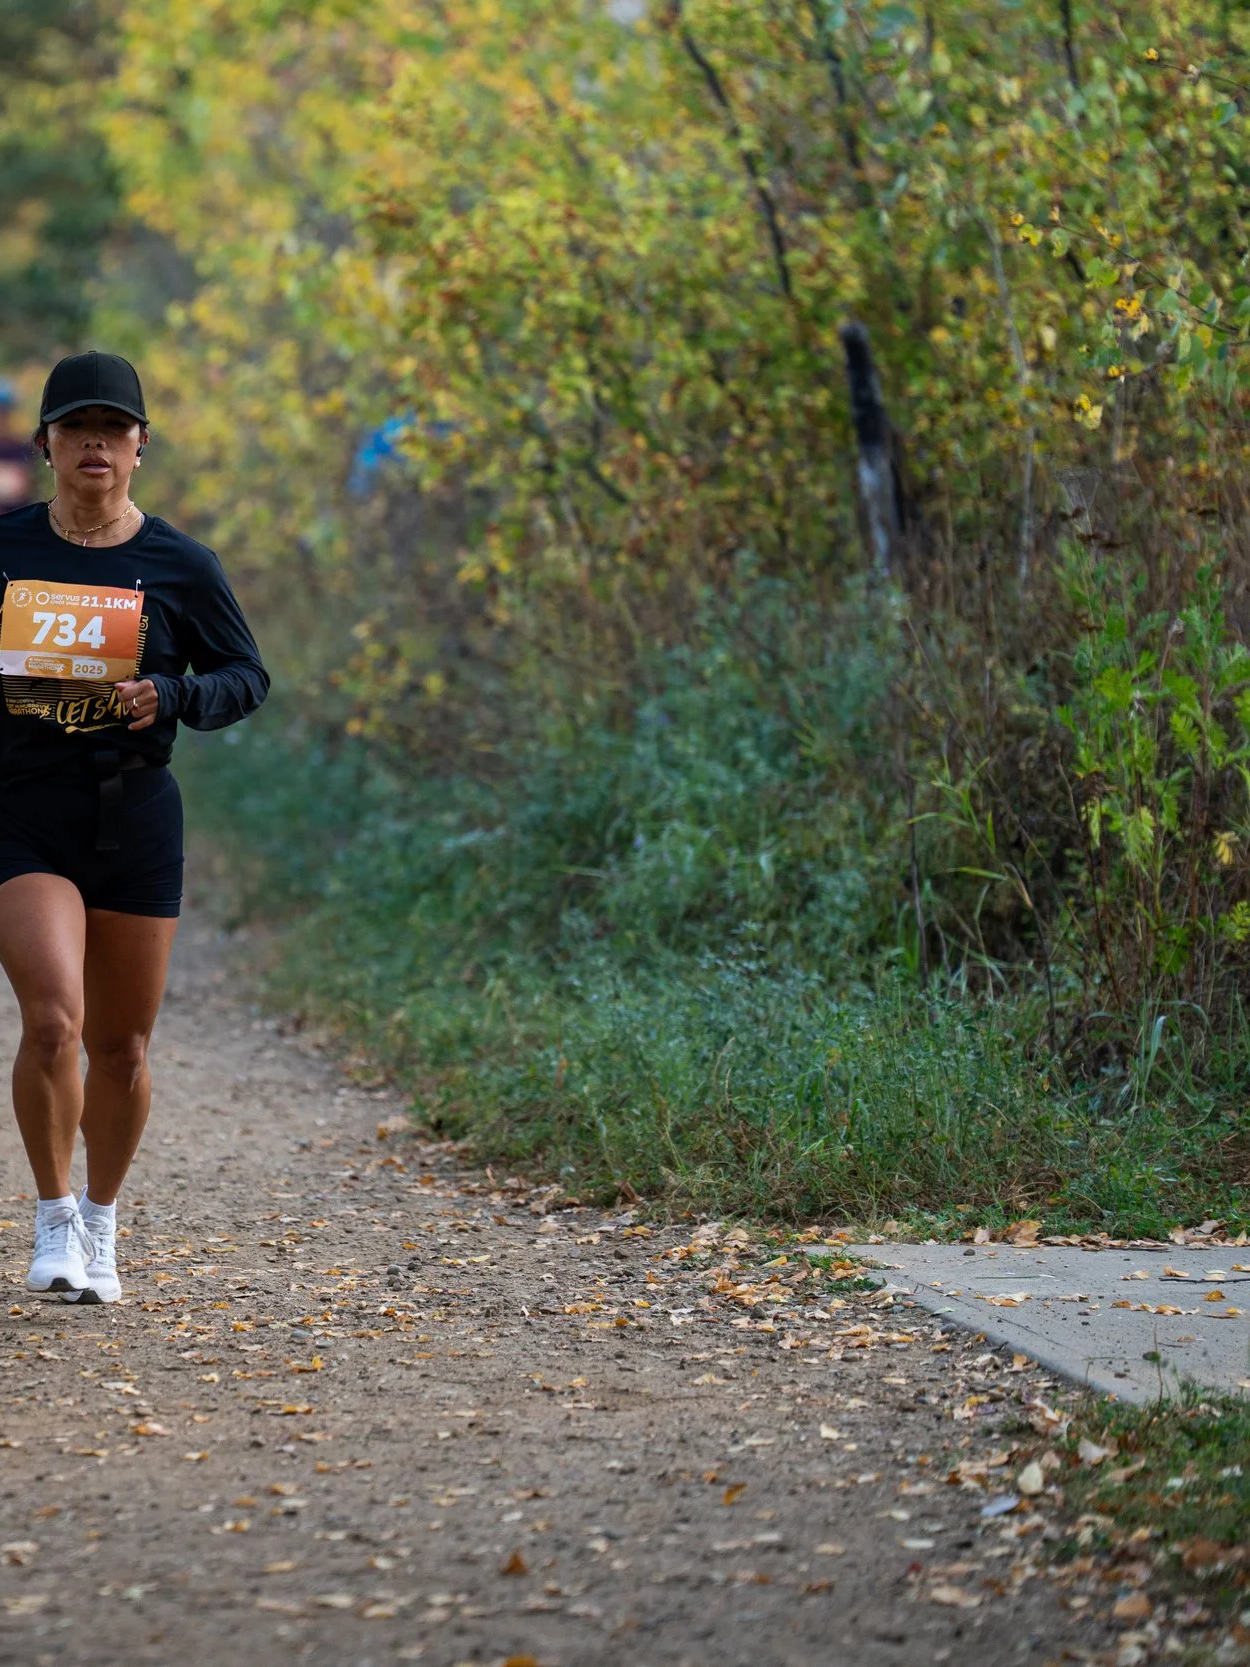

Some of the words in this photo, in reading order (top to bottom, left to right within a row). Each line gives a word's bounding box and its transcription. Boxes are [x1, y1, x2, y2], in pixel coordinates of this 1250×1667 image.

[50, 593, 80, 602] servus
[81, 595, 137, 611] 21.1KM
[31, 612, 106, 649] 734
[74, 663, 103, 675] 2025
